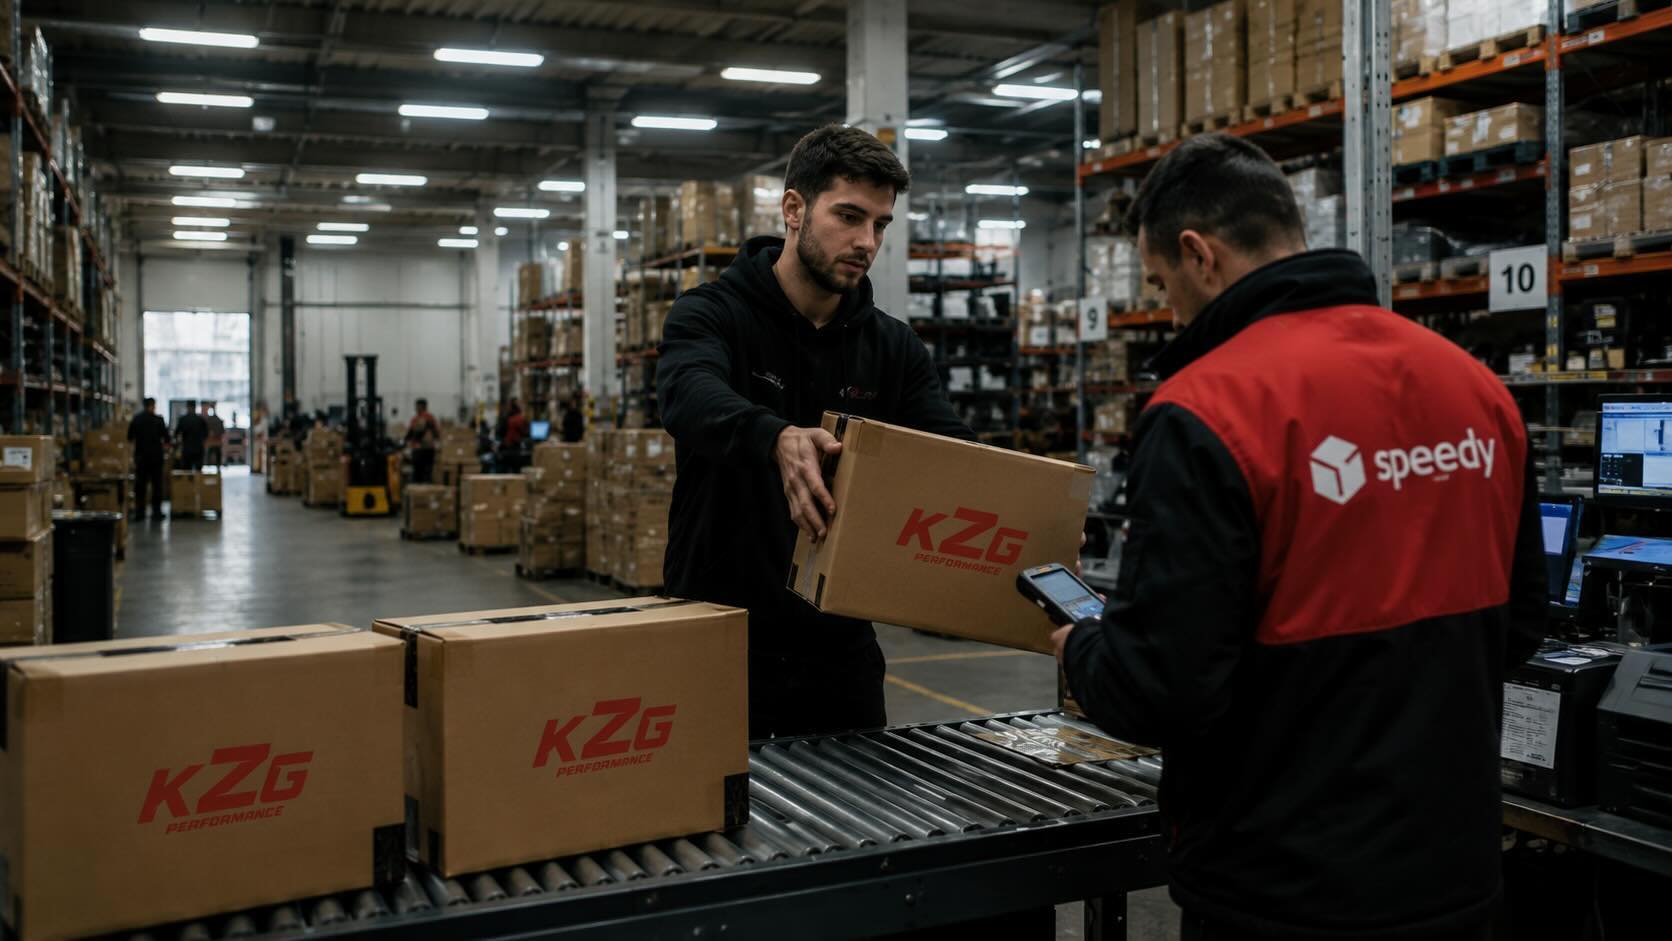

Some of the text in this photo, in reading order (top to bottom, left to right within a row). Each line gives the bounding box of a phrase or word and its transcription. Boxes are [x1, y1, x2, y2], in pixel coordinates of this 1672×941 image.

[1502, 263, 1535, 294] 10
[1088, 307, 1099, 331] 9
[1374, 427, 1495, 491] speedy
[896, 506, 1029, 566] KZG
[914, 553, 1003, 576] PERFORMANCE
[532, 696, 677, 768] KZG
[556, 752, 654, 778] PERFORMANCE
[137, 743, 314, 824] KZG
[165, 805, 285, 834] PERFORMANCE
